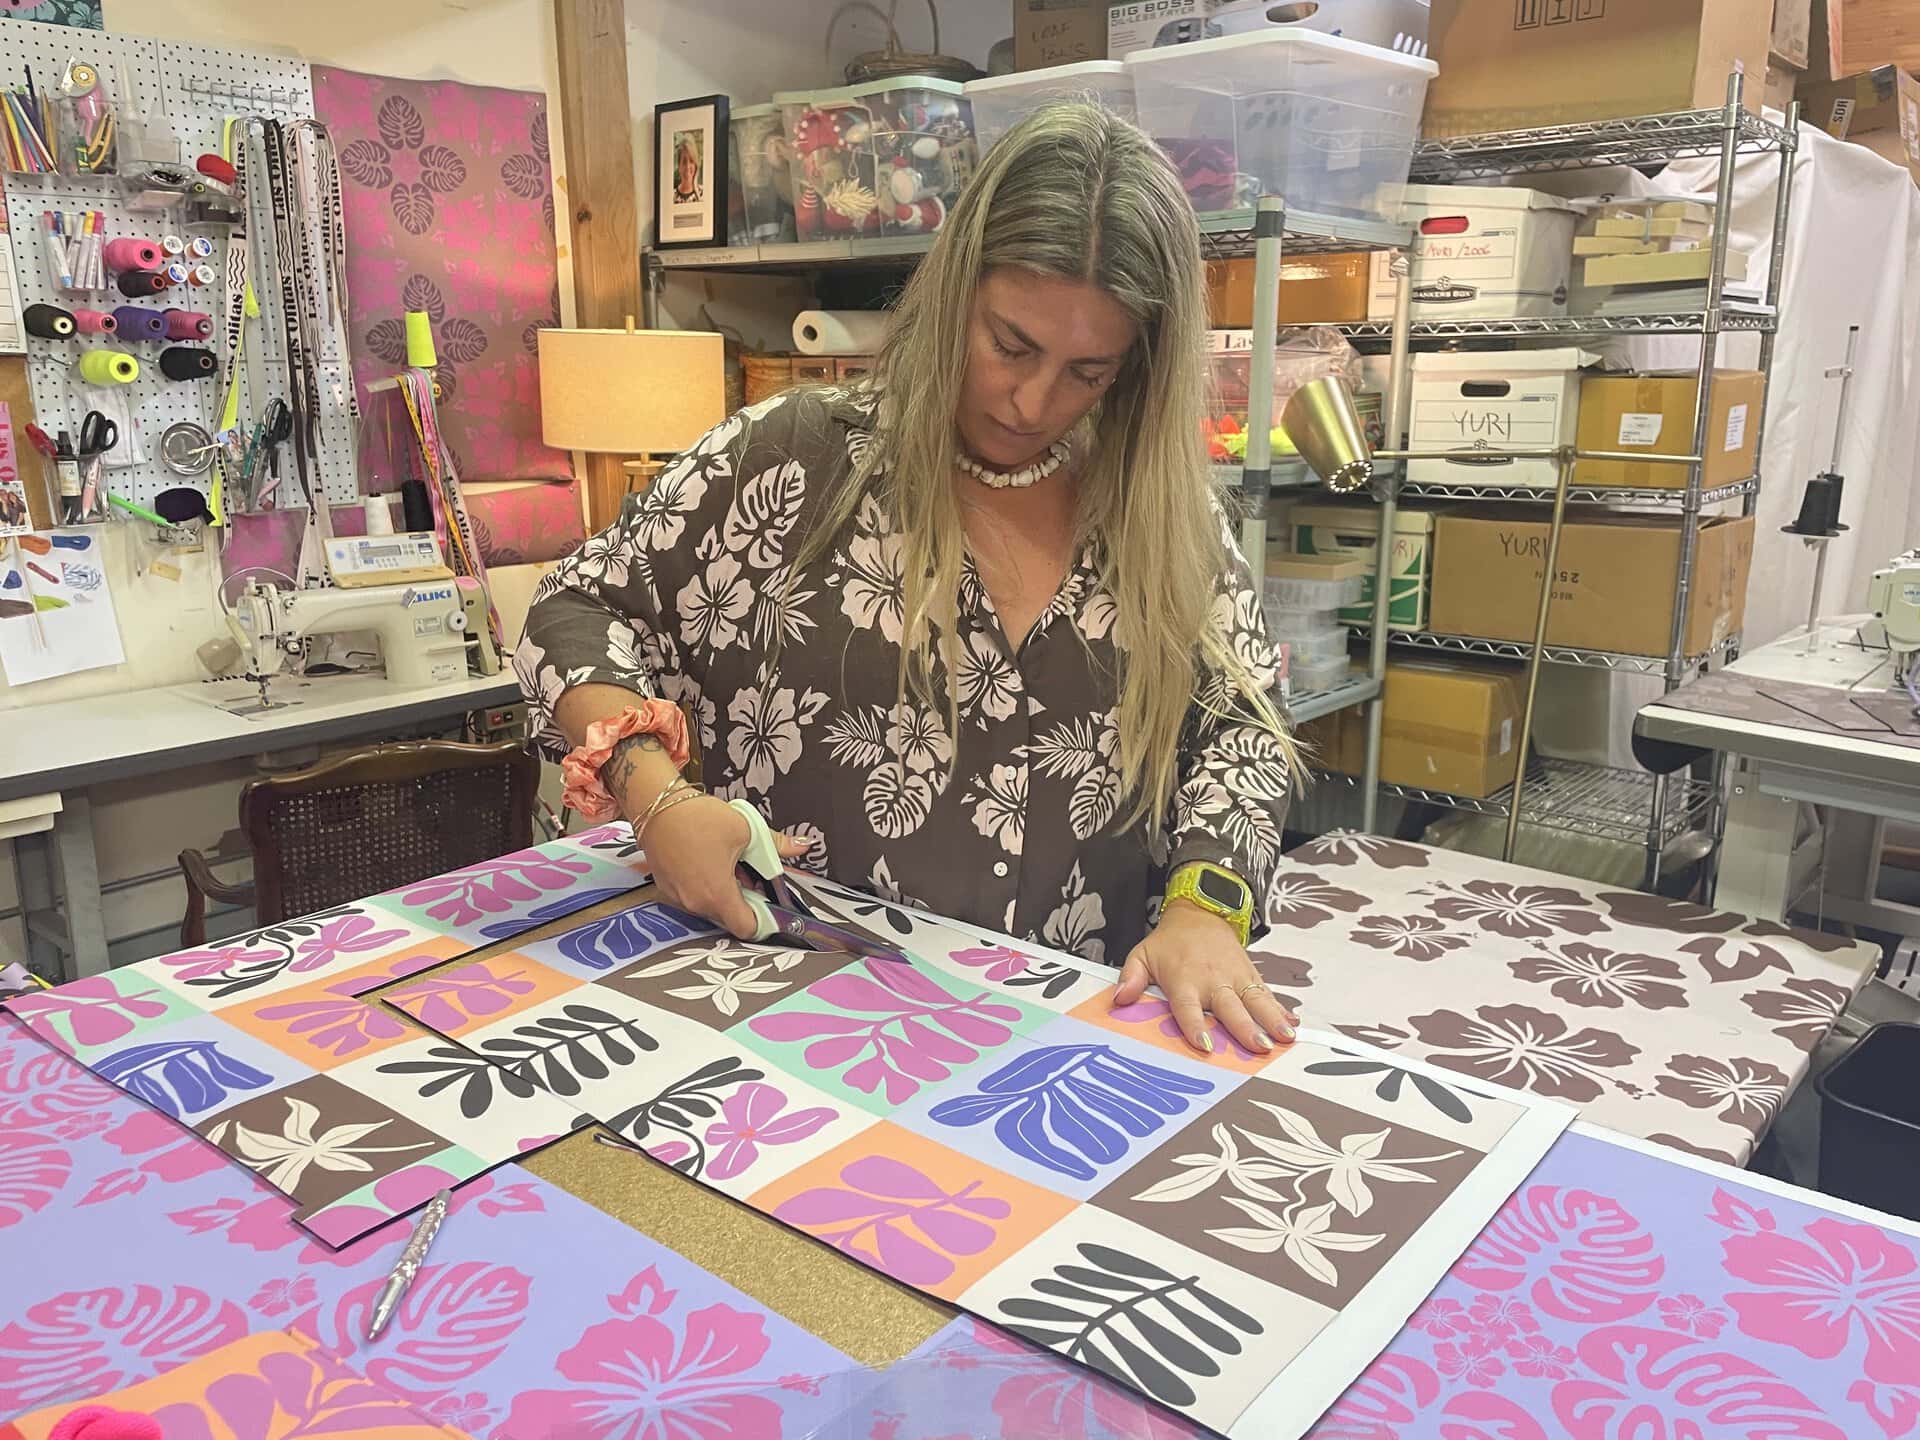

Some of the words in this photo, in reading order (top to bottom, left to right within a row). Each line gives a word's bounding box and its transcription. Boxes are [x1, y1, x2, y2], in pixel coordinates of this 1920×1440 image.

[1111, 6, 1138, 19] BIG
[1145, 0, 1194, 13] BOSS
[228, 293, 243, 350] Olitas
[1452, 409, 1511, 441] YURI
[1499, 531, 1547, 558] YURI
[415, 589, 452, 603] JUKI
